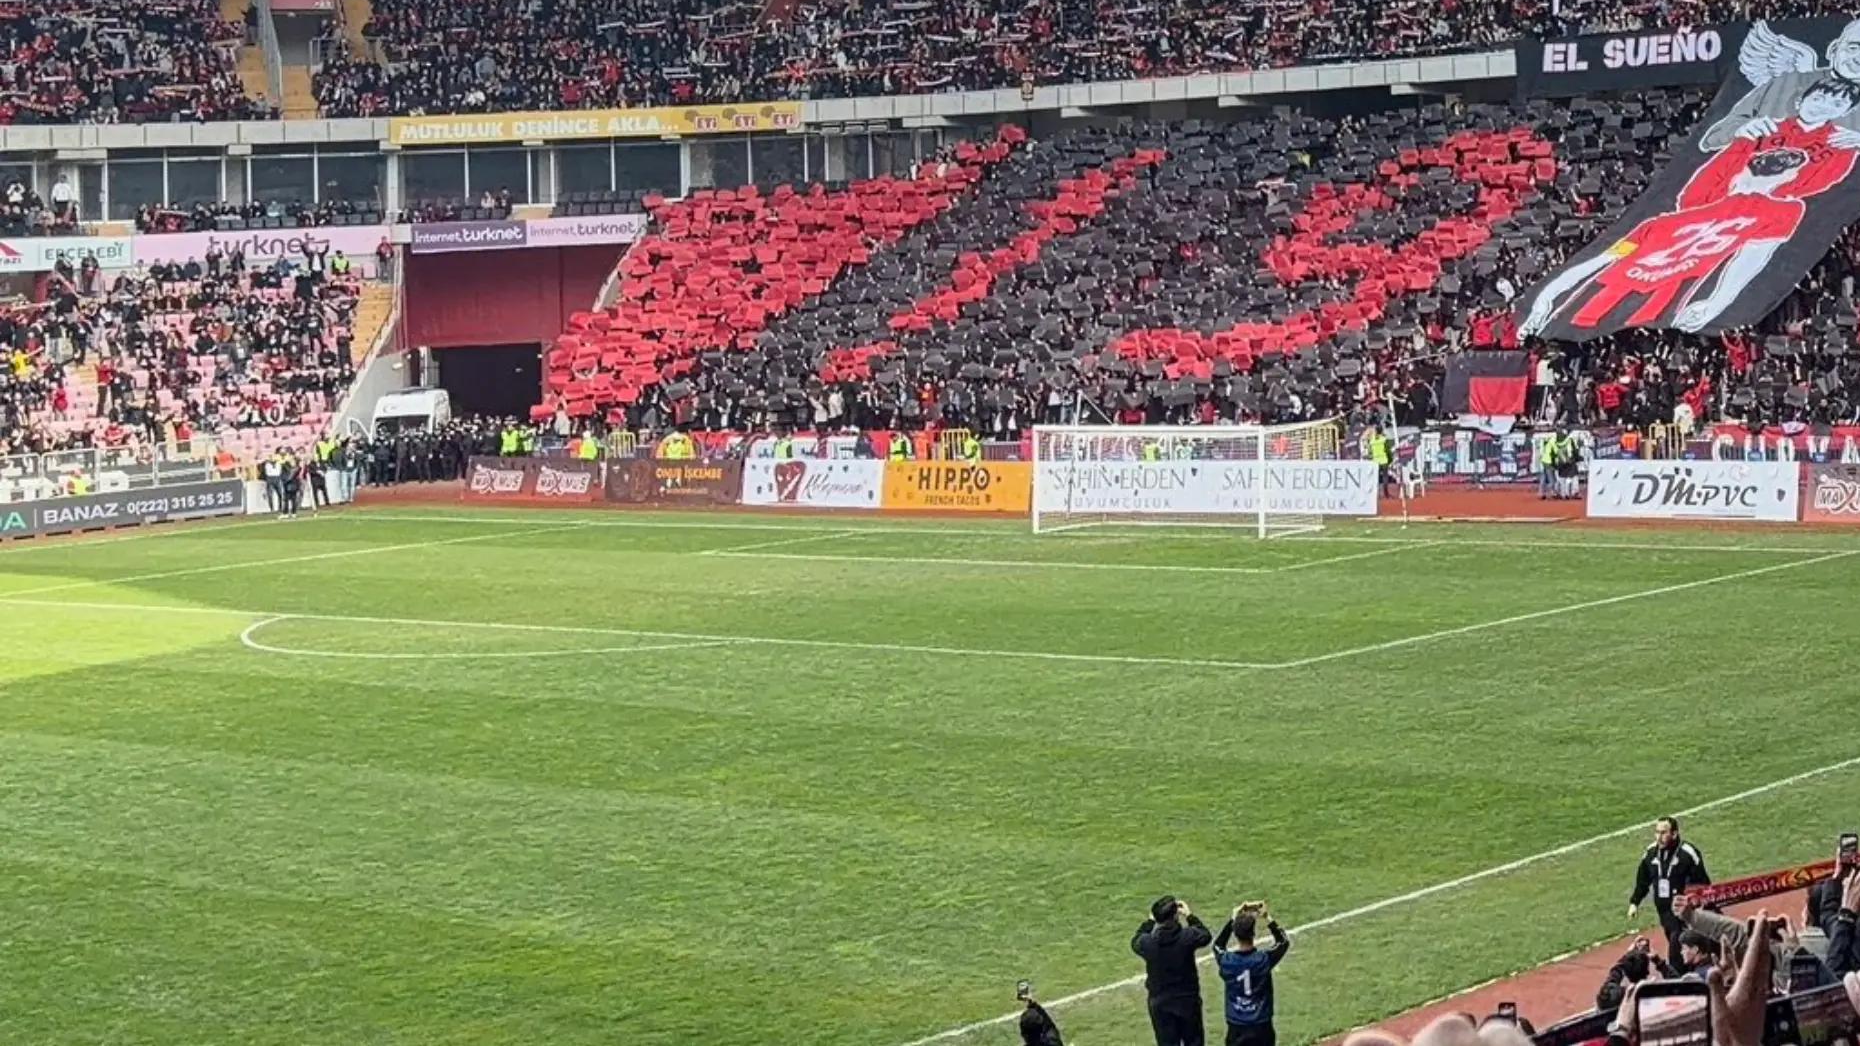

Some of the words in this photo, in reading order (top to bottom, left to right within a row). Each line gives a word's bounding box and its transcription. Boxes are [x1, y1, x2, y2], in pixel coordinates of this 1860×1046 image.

[1542, 41, 1588, 73] EL
[1603, 27, 1722, 68] SUEÑO
[401, 121, 504, 139] MUTLULUK
[512, 116, 599, 137] DENİNCE
[463, 225, 523, 242] turknet
[577, 221, 636, 235] turknet
[1120, 467, 1187, 489] ERDEN
[1293, 468, 1362, 490] ERDEN
[44, 503, 119, 524] BANAZ
[127, 501, 168, 514] 0(222)
[171, 497, 197, 510] 315
[198, 494, 215, 508] 25
[217, 492, 233, 505] 25
[1233, 497, 1348, 510] KUUMCULUK
[1237, 969, 1251, 995] 1
